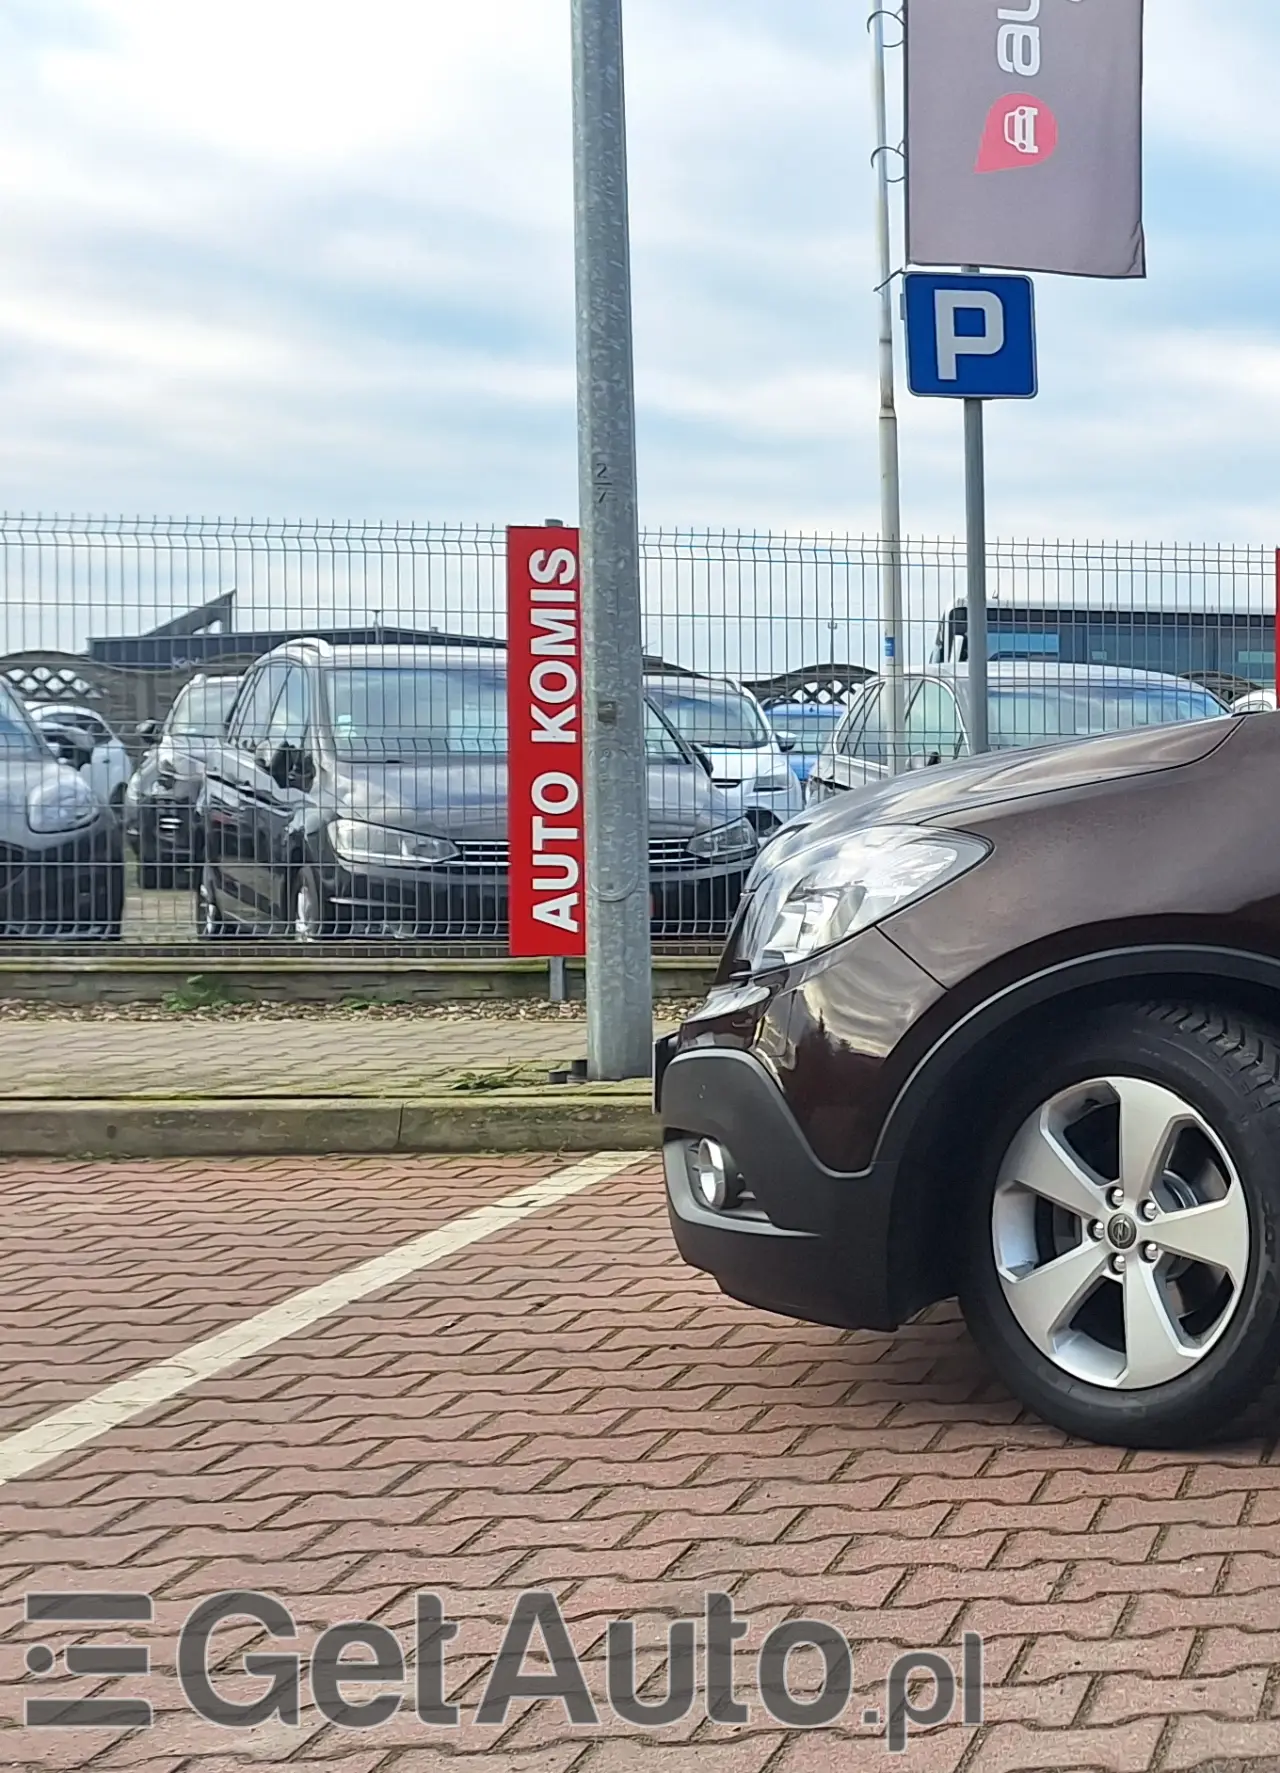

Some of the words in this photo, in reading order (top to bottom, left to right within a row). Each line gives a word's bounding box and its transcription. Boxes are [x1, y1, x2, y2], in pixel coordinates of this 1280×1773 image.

[934, 289, 1004, 381] P
[528, 546, 578, 744] KOMIS
[531, 771, 580, 933] AUTO
